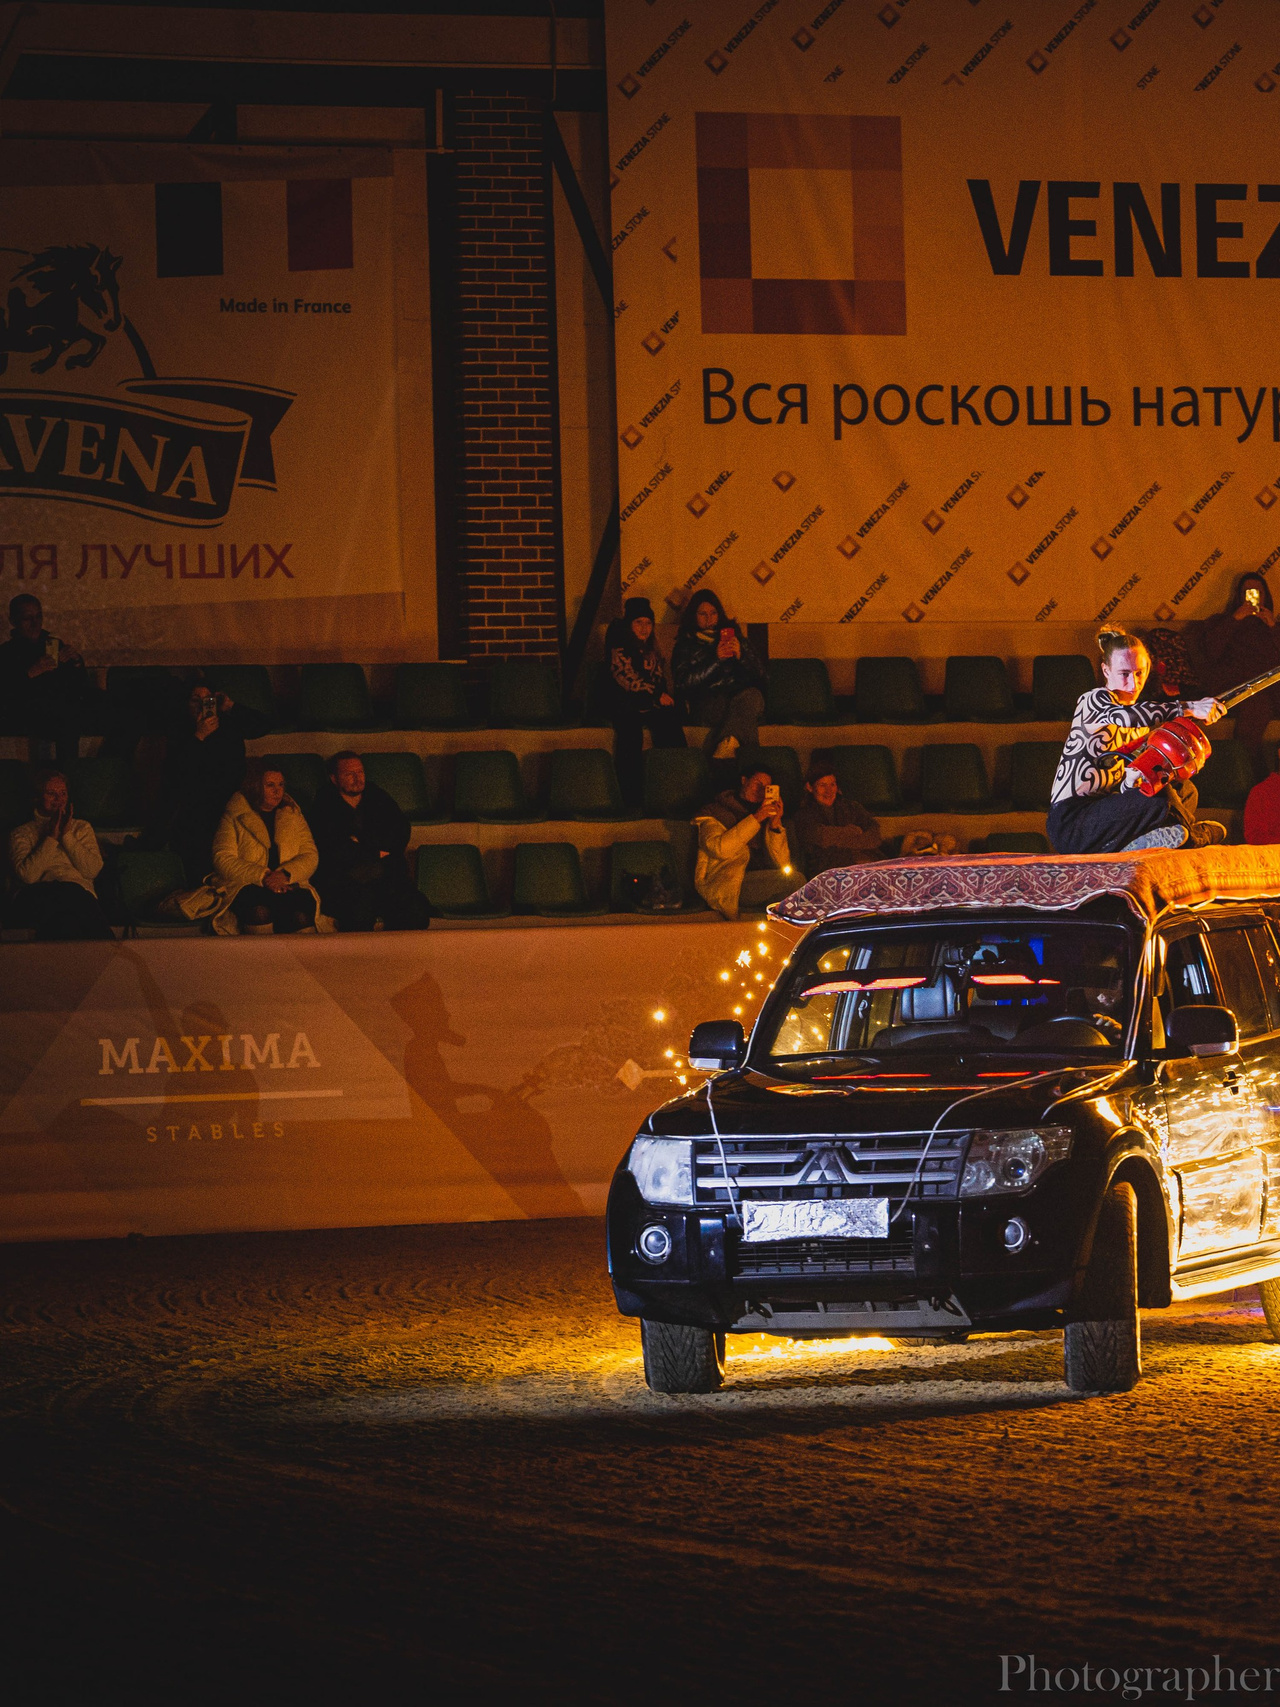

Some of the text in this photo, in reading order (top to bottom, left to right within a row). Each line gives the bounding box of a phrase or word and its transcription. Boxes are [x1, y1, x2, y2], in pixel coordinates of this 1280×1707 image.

[636, 18, 693, 78] VENEZIA STONE
[723, 18, 758, 54] VENEZIA
[960, 19, 1014, 77] VENEZIA STONE
[1044, 19, 1078, 54] VENEZIA
[905, 41, 931, 69] STONE
[1219, 41, 1243, 68] STONE
[1136, 63, 1161, 91] STONE
[615, 112, 672, 172] VENEZIA STONE
[624, 205, 651, 234] STONE
[219, 298, 352, 314] Made in France
[639, 392, 675, 428] VENEZIA
[703, 367, 809, 426] Вся
[833, 382, 1111, 440] роскошь
[619, 462, 674, 523] VENEZIA STONE
[856, 479, 911, 539] VENEZIA STONE
[940, 478, 975, 513] VENEZIA
[1108, 480, 1163, 540] VENEZIA STONE
[1191, 479, 1225, 515] VENEZIA
[770, 504, 826, 564] VENEZIA STONE
[1025, 505, 1080, 565] VENEZIA STONE
[75, 543, 295, 580] ЛУЧШИХ
[627, 556, 653, 584] STONE
[683, 530, 740, 591] VENEZIA STONE
[920, 546, 975, 606] VENEZIA STONE
[1171, 547, 1224, 606] VENEZIA STONE
[865, 571, 890, 599] STONE
[1118, 572, 1142, 599] STONE
[779, 597, 804, 623] STONE
[1035, 598, 1059, 623] STONE
[98, 1031, 322, 1075] MAXIMA
[146, 1121, 285, 1143] STABLES
